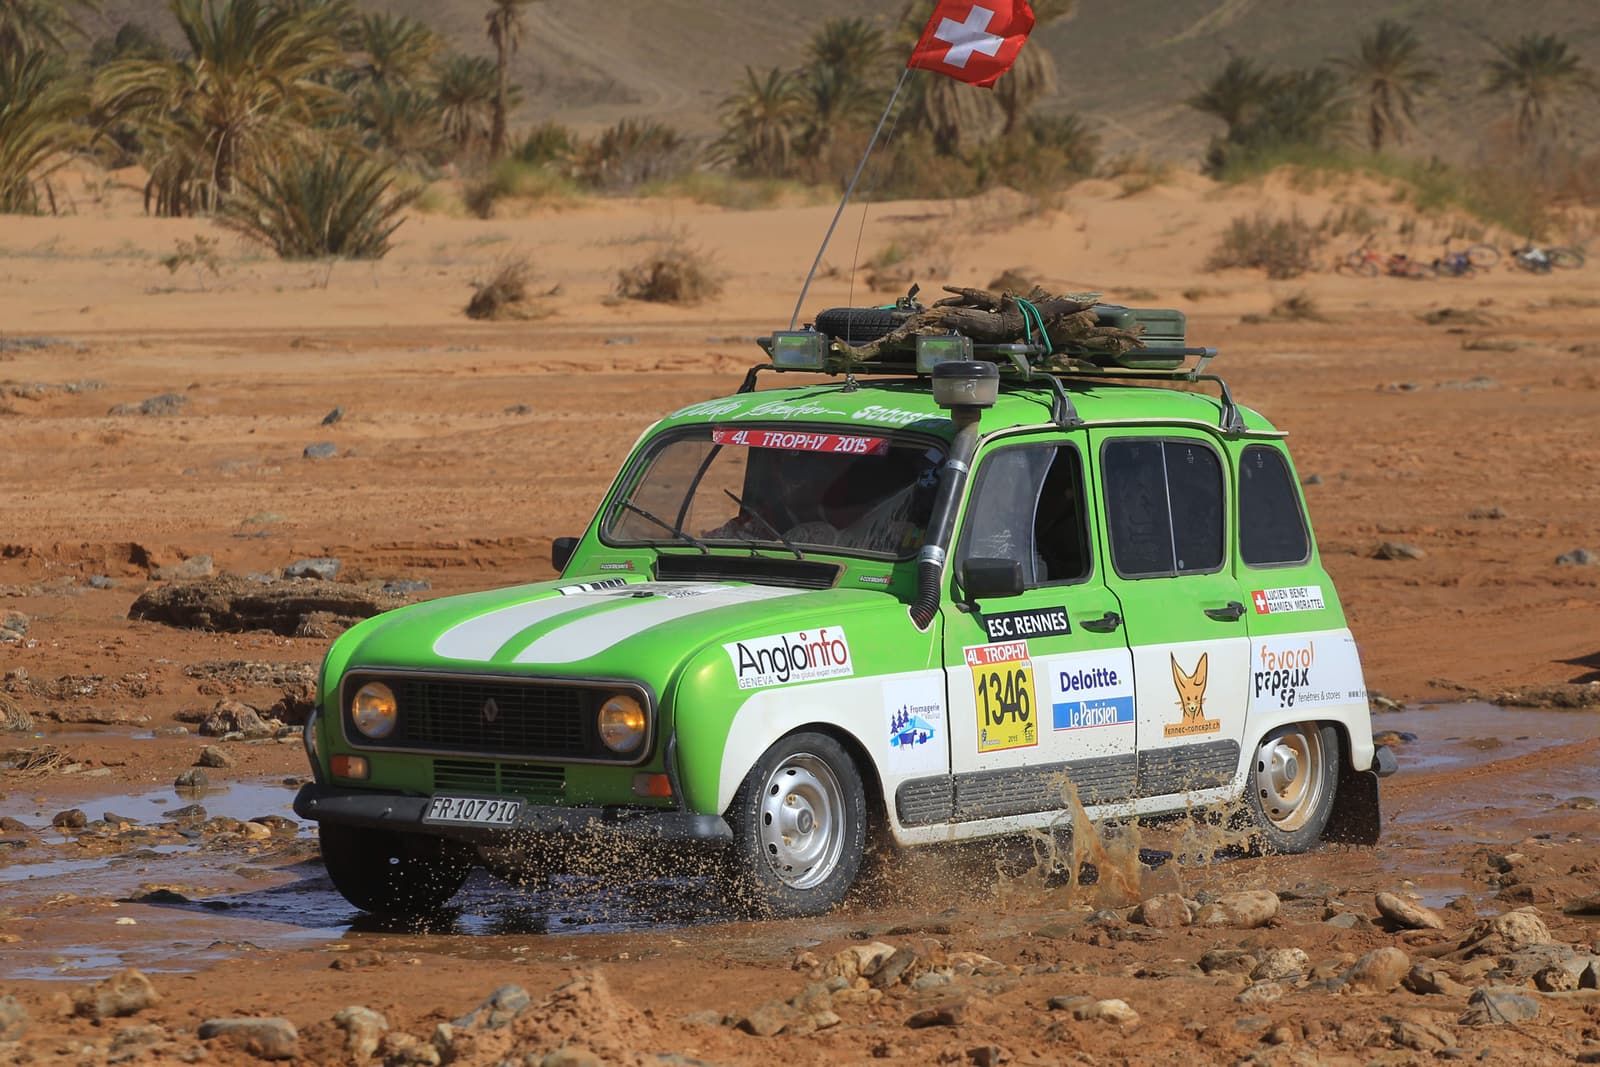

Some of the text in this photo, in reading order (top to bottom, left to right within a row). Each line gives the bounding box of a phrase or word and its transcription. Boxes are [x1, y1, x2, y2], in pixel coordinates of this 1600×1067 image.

[731, 430, 871, 453] 4L TROPHY 2015
[1266, 587, 1309, 600] LUCIEN BENEY
[1269, 599, 1325, 612] DAMIEN MORATTEL
[987, 612, 1067, 637] ESC RENNES
[737, 629, 848, 683] Angloinfo
[967, 643, 1026, 665] 4L TROPHY
[1260, 641, 1314, 671] favorol
[739, 676, 773, 688] GENEVA
[1254, 667, 1309, 698] papaux
[978, 669, 1030, 726] 1346
[1280, 688, 1296, 708] sa
